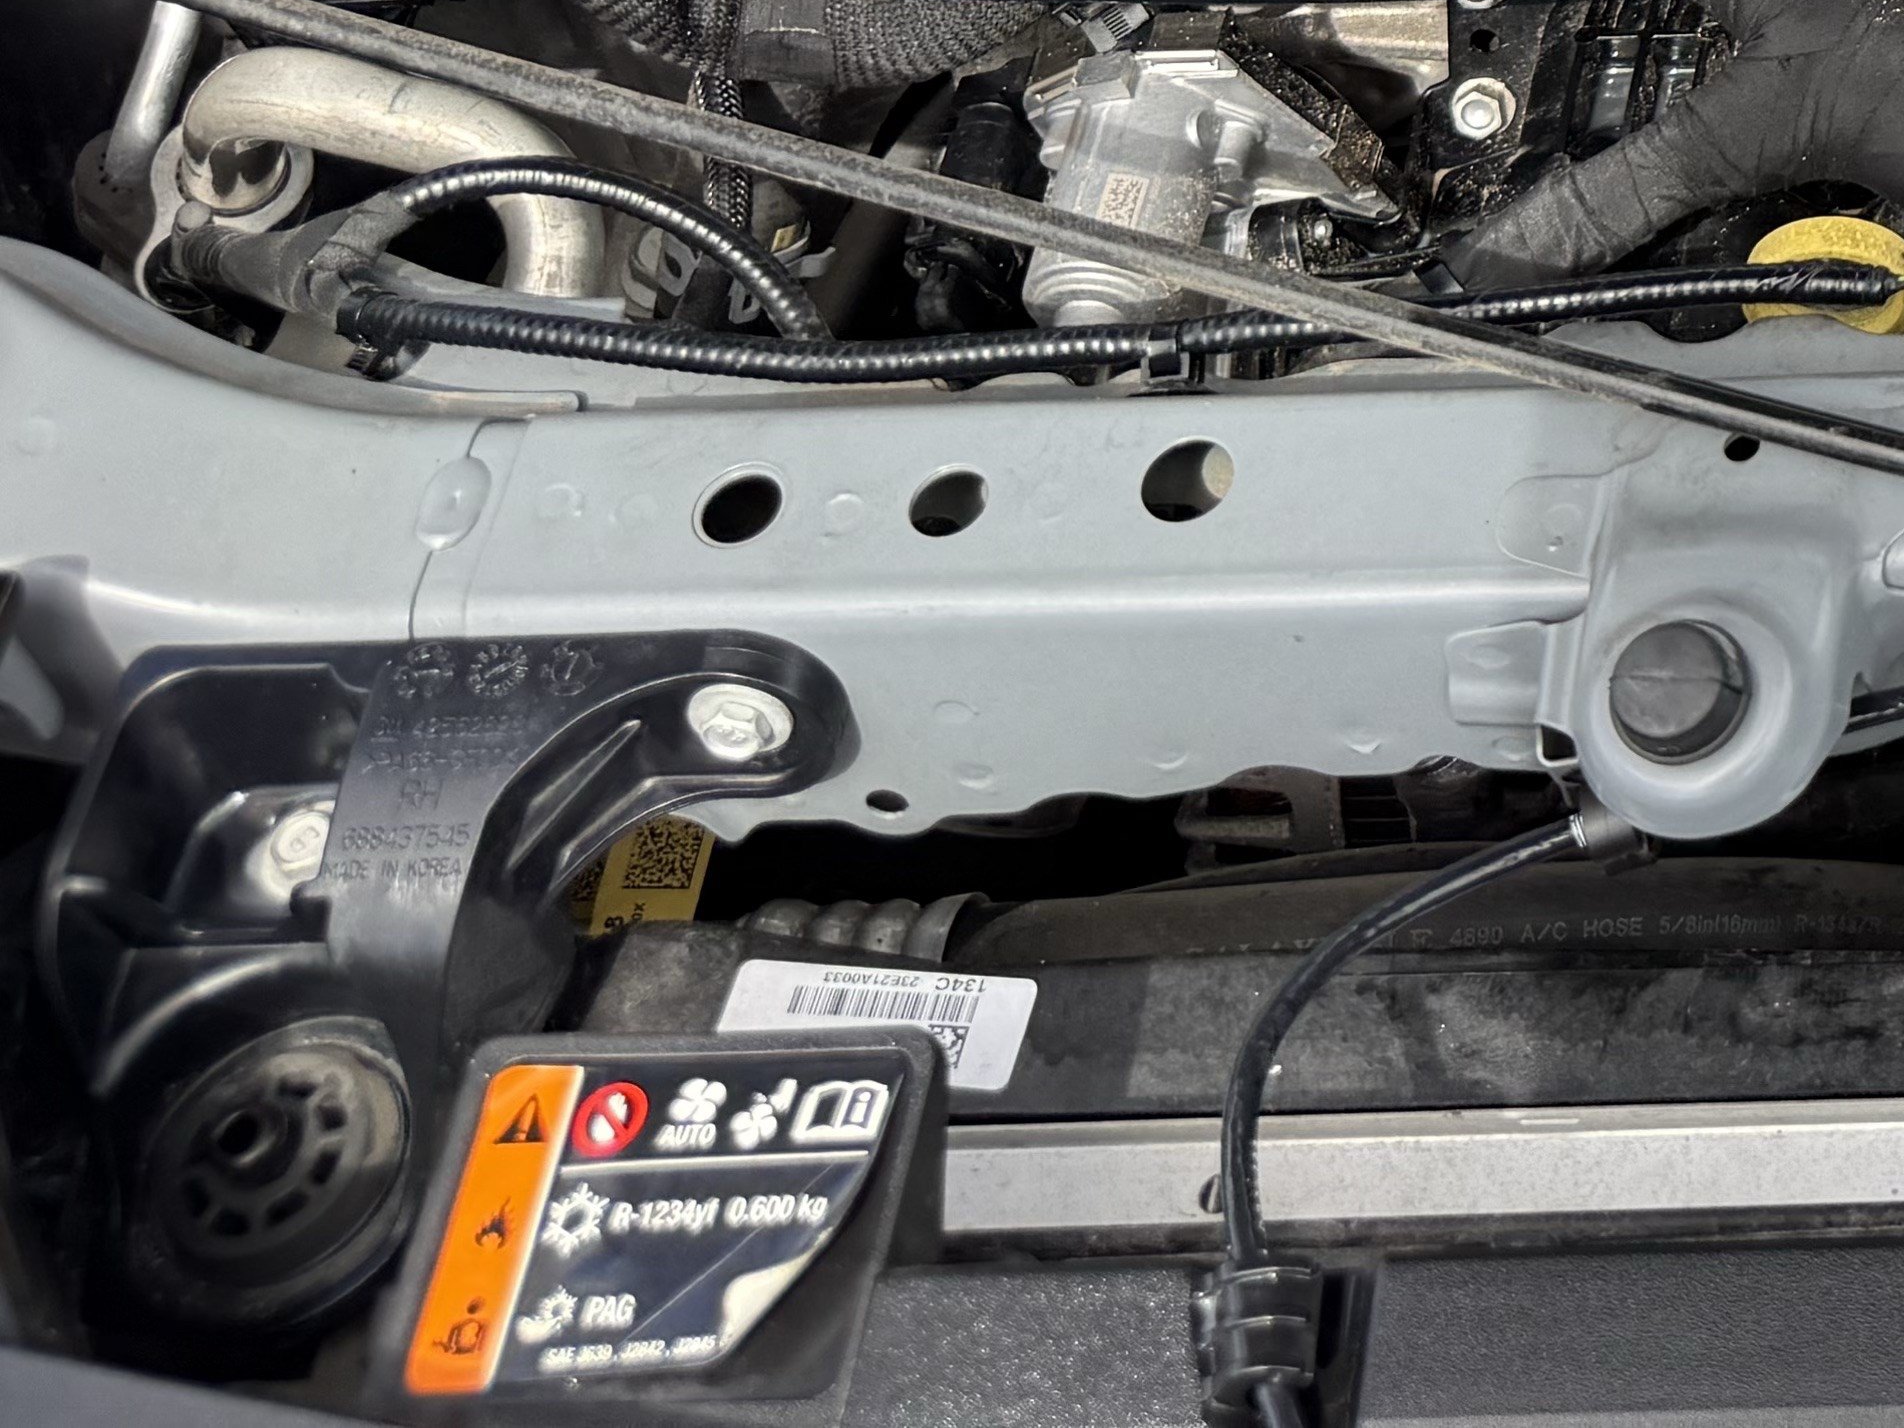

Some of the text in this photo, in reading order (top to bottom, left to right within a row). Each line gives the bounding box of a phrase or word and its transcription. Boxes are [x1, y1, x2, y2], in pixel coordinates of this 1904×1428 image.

[381, 858, 399, 878] IN
[407, 856, 462, 878] KOREA
[1520, 920, 1568, 943] A/C
[1582, 916, 1644, 938] HOSE
[821, 972, 987, 993] 134C 23E21A0033
[657, 1123, 717, 1148] AUTO
[608, 1193, 829, 1235] R-1234yf 0.600 kg
[580, 1293, 637, 1330] PAG
[541, 1345, 575, 1369] SAE
